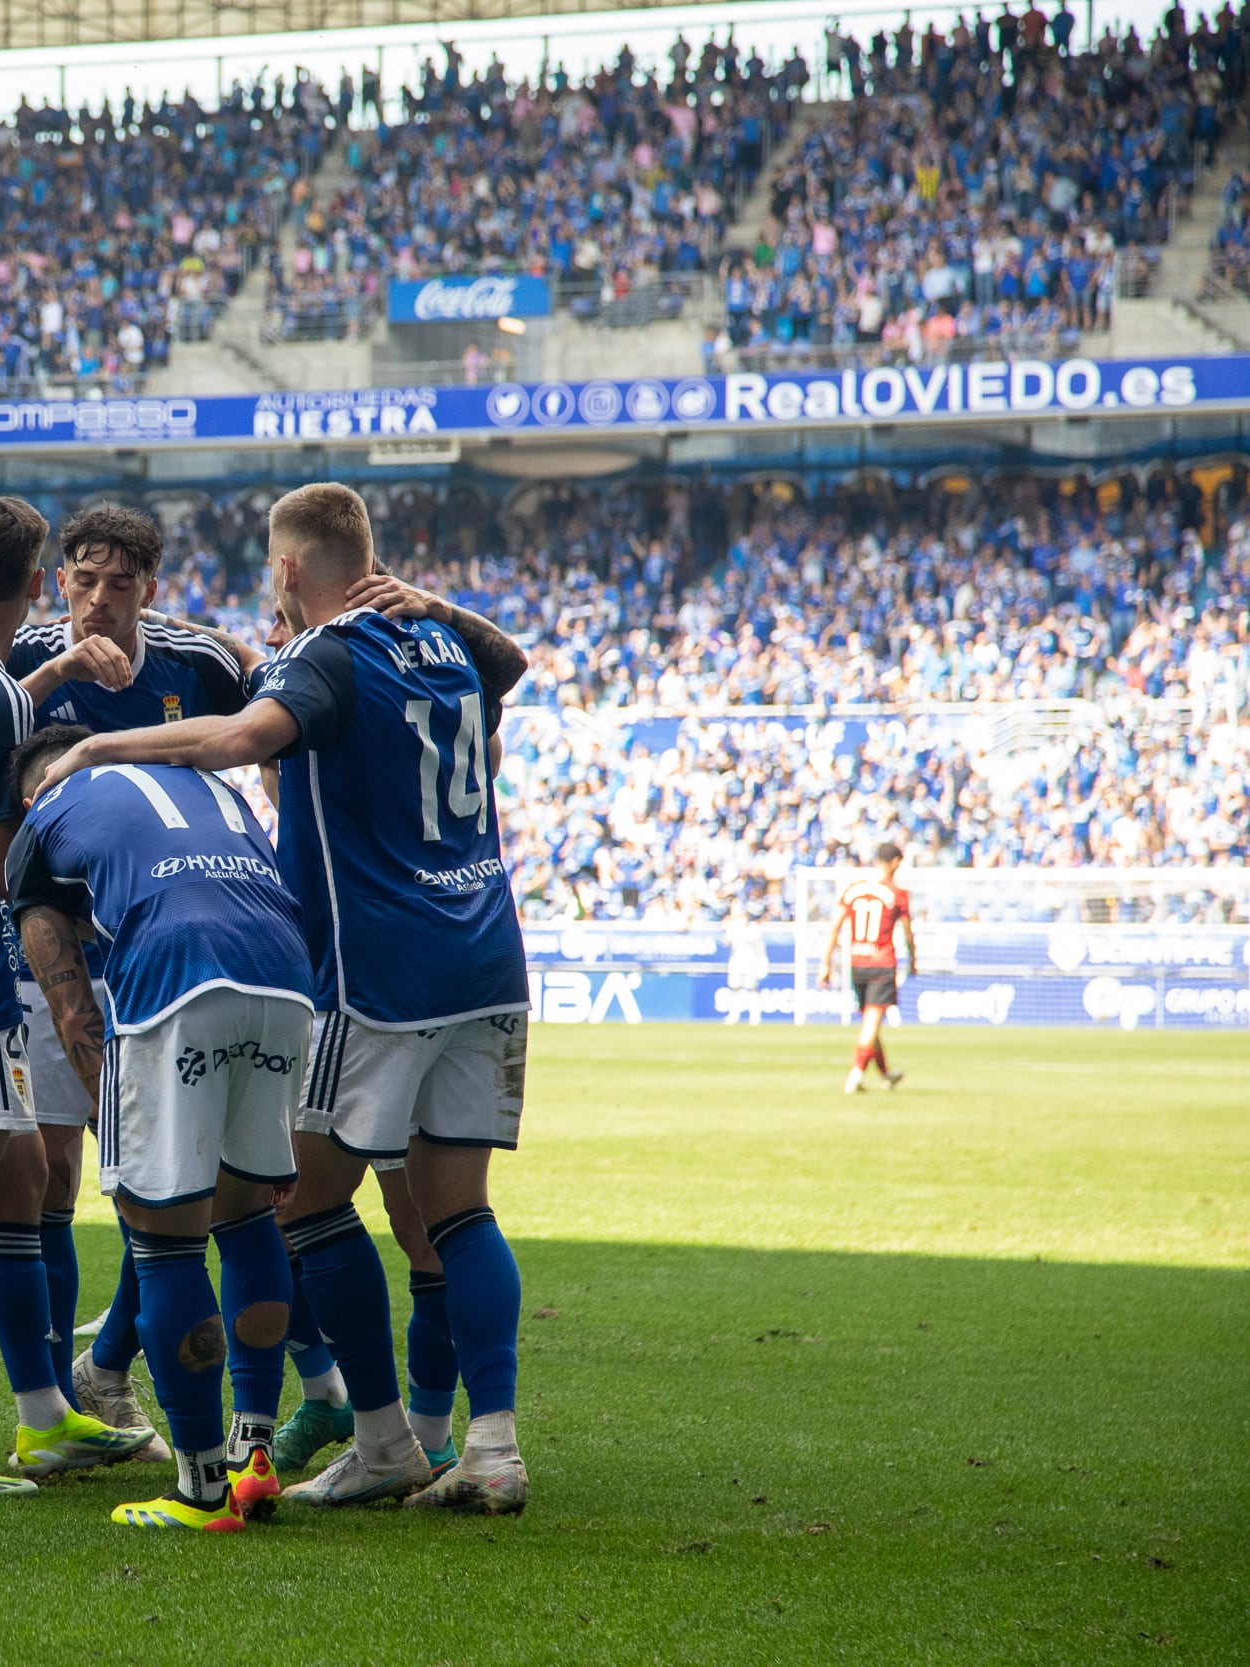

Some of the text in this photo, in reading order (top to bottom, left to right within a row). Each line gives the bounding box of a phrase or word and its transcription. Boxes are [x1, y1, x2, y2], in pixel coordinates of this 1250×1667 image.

[414, 276, 518, 321] Coca-Cola
[724, 357, 1198, 423] RealOVIEDO.es
[253, 406, 438, 440] RIESTRA
[405, 692, 488, 842] 14
[205, 869, 250, 881] Asturdai
[852, 897, 884, 942] 11
